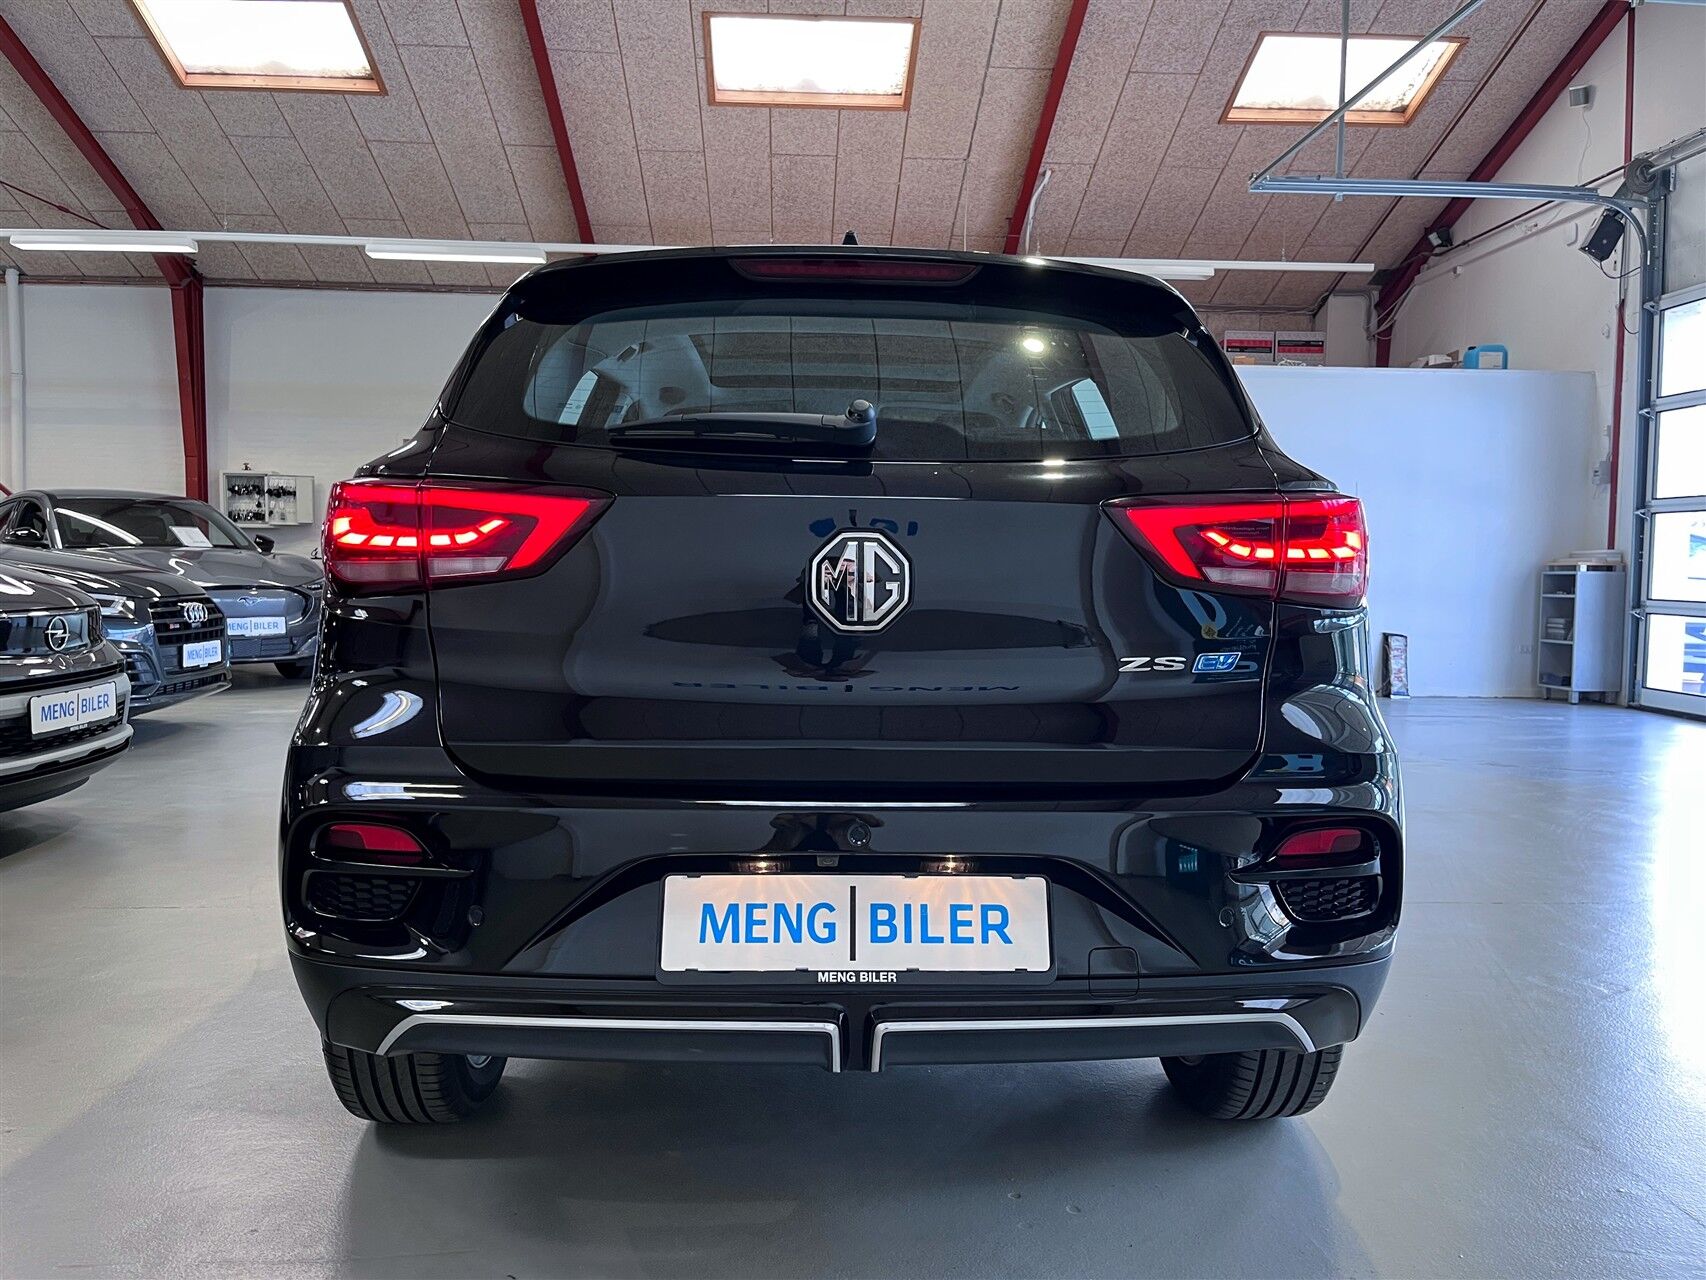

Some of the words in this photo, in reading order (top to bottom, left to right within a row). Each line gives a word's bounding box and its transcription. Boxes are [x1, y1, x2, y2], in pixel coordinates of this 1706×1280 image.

[821, 541, 901, 622] MG
[253, 621, 279, 631] BILER
[1118, 656, 1187, 672] ZS
[1196, 654, 1238, 671] EV
[41, 700, 75, 722] MENG
[81, 693, 110, 714] BILER
[699, 902, 837, 944] MENG
[870, 902, 1014, 944] BILER
[817, 971, 856, 983] MENG
[860, 971, 897, 983] BILER
